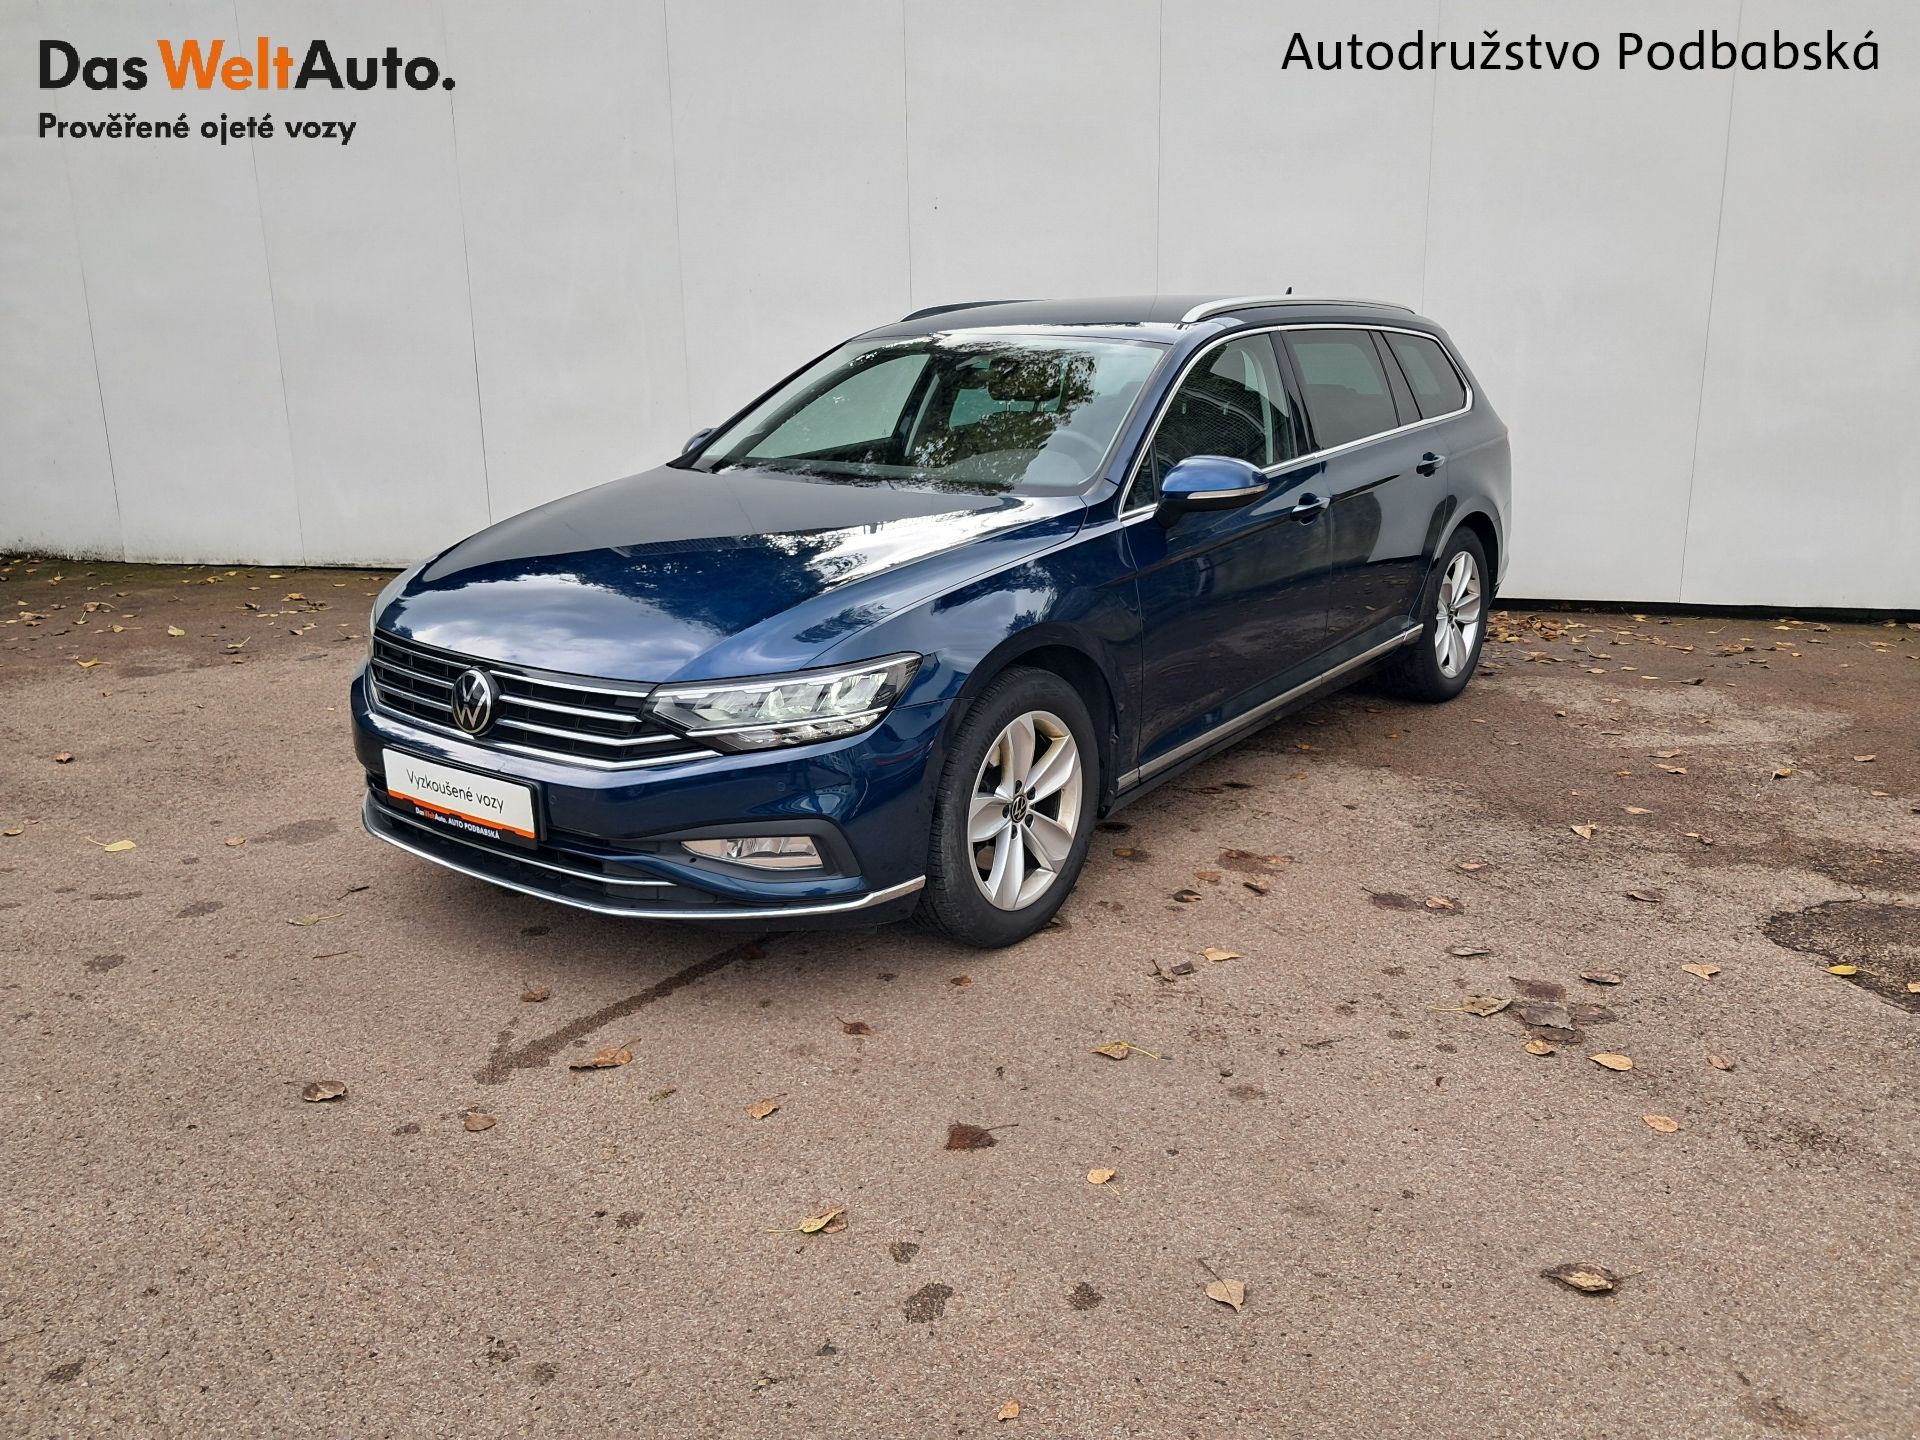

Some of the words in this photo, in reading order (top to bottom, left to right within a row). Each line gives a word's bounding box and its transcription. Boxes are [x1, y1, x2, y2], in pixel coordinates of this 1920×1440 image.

[406, 768, 473, 802] Vyzkoušené
[476, 792, 504, 814] vozy
[448, 817, 464, 830] AUTO
